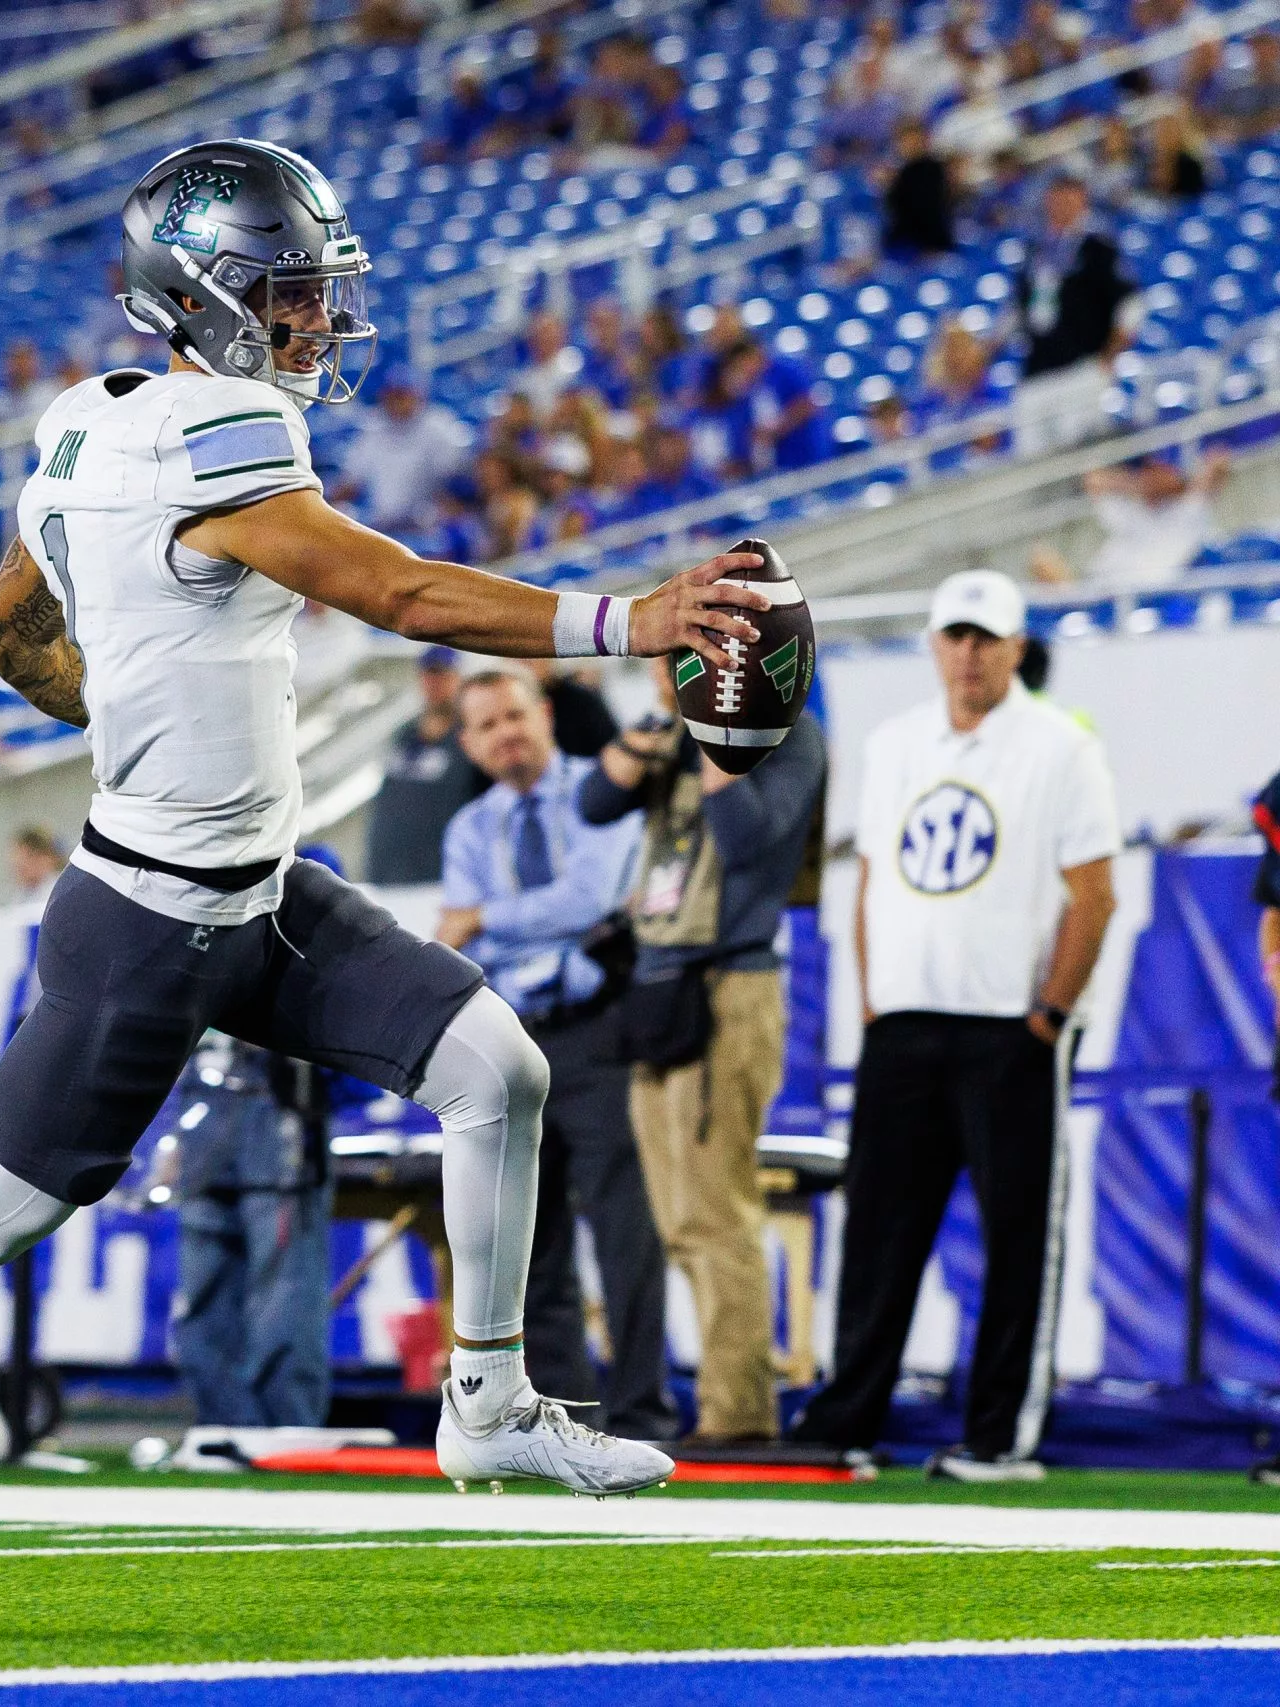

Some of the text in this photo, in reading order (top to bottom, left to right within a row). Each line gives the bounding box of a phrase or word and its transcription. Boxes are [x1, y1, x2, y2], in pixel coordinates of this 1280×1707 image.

[151, 167, 241, 255] E
[42, 429, 88, 481] KIM
[39, 513, 91, 724] 1
[898, 784, 998, 892] SEC
